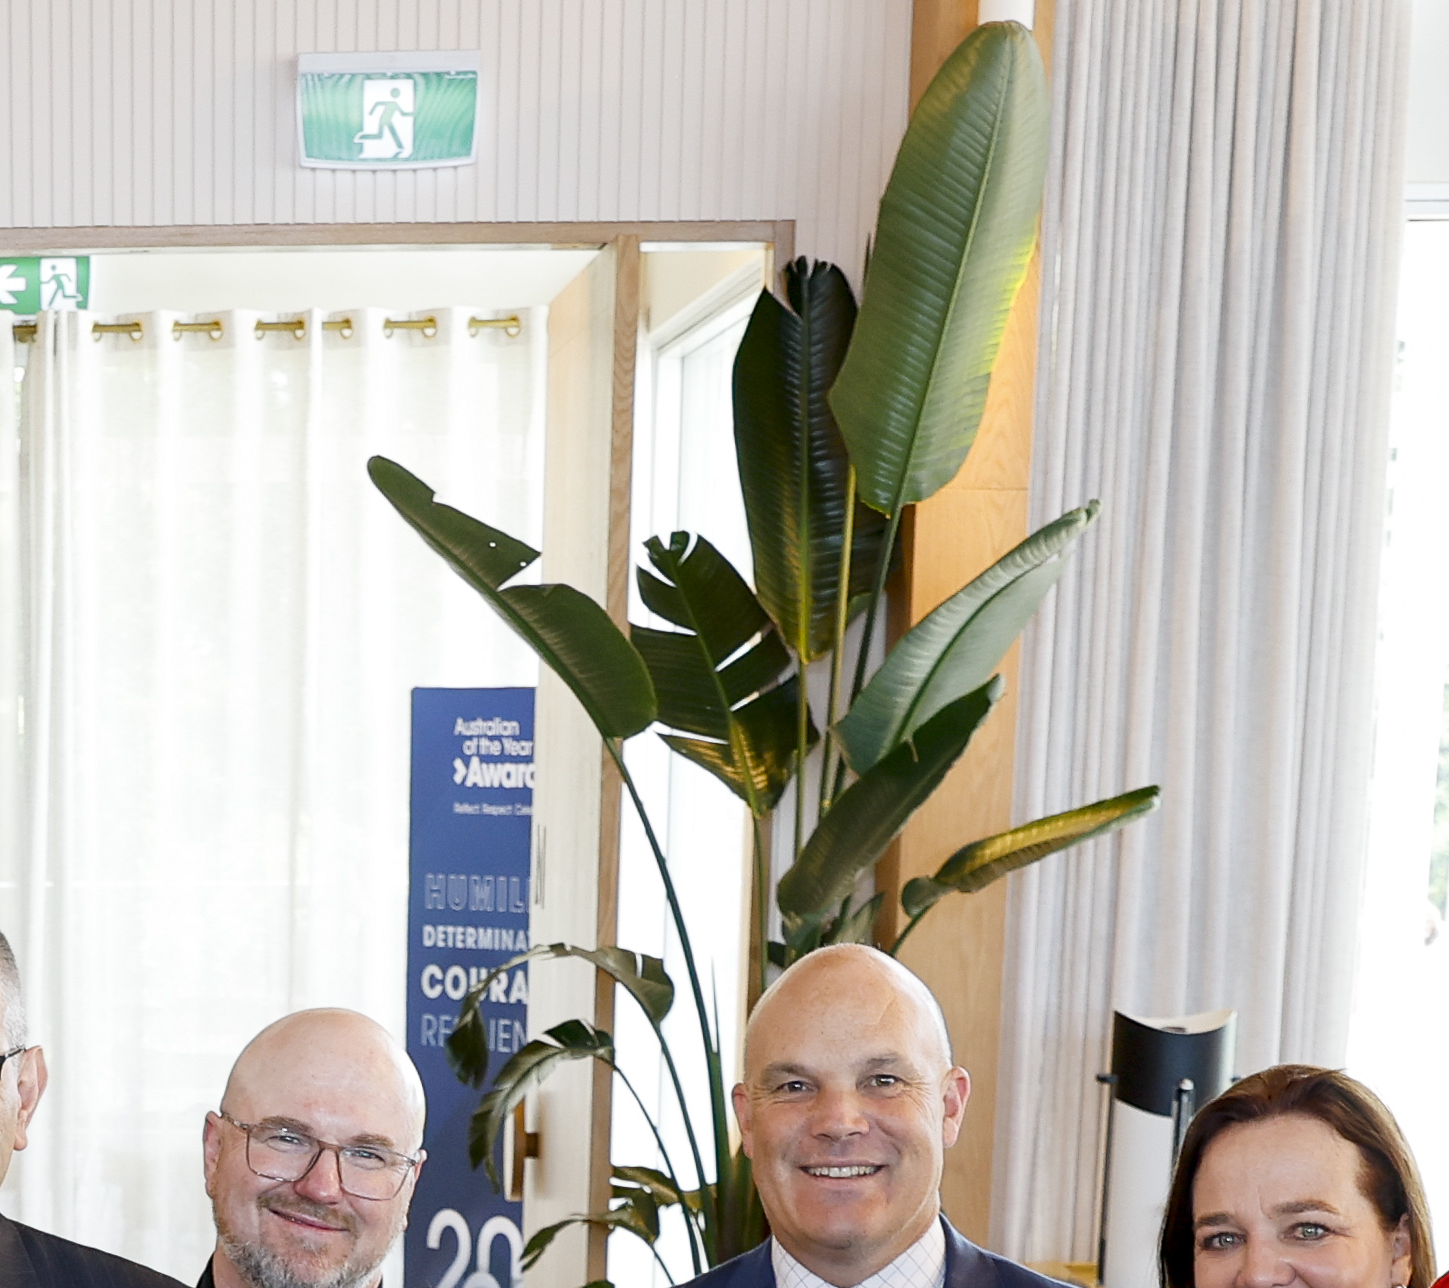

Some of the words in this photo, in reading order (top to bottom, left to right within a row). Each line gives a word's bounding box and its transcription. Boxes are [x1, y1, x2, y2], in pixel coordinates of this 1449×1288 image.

[453, 716, 520, 736] Australian
[462, 736, 478, 756] of
[479, 736, 502, 756] the
[502, 736, 533, 756] Year
[422, 924, 529, 951] DETERMINA
